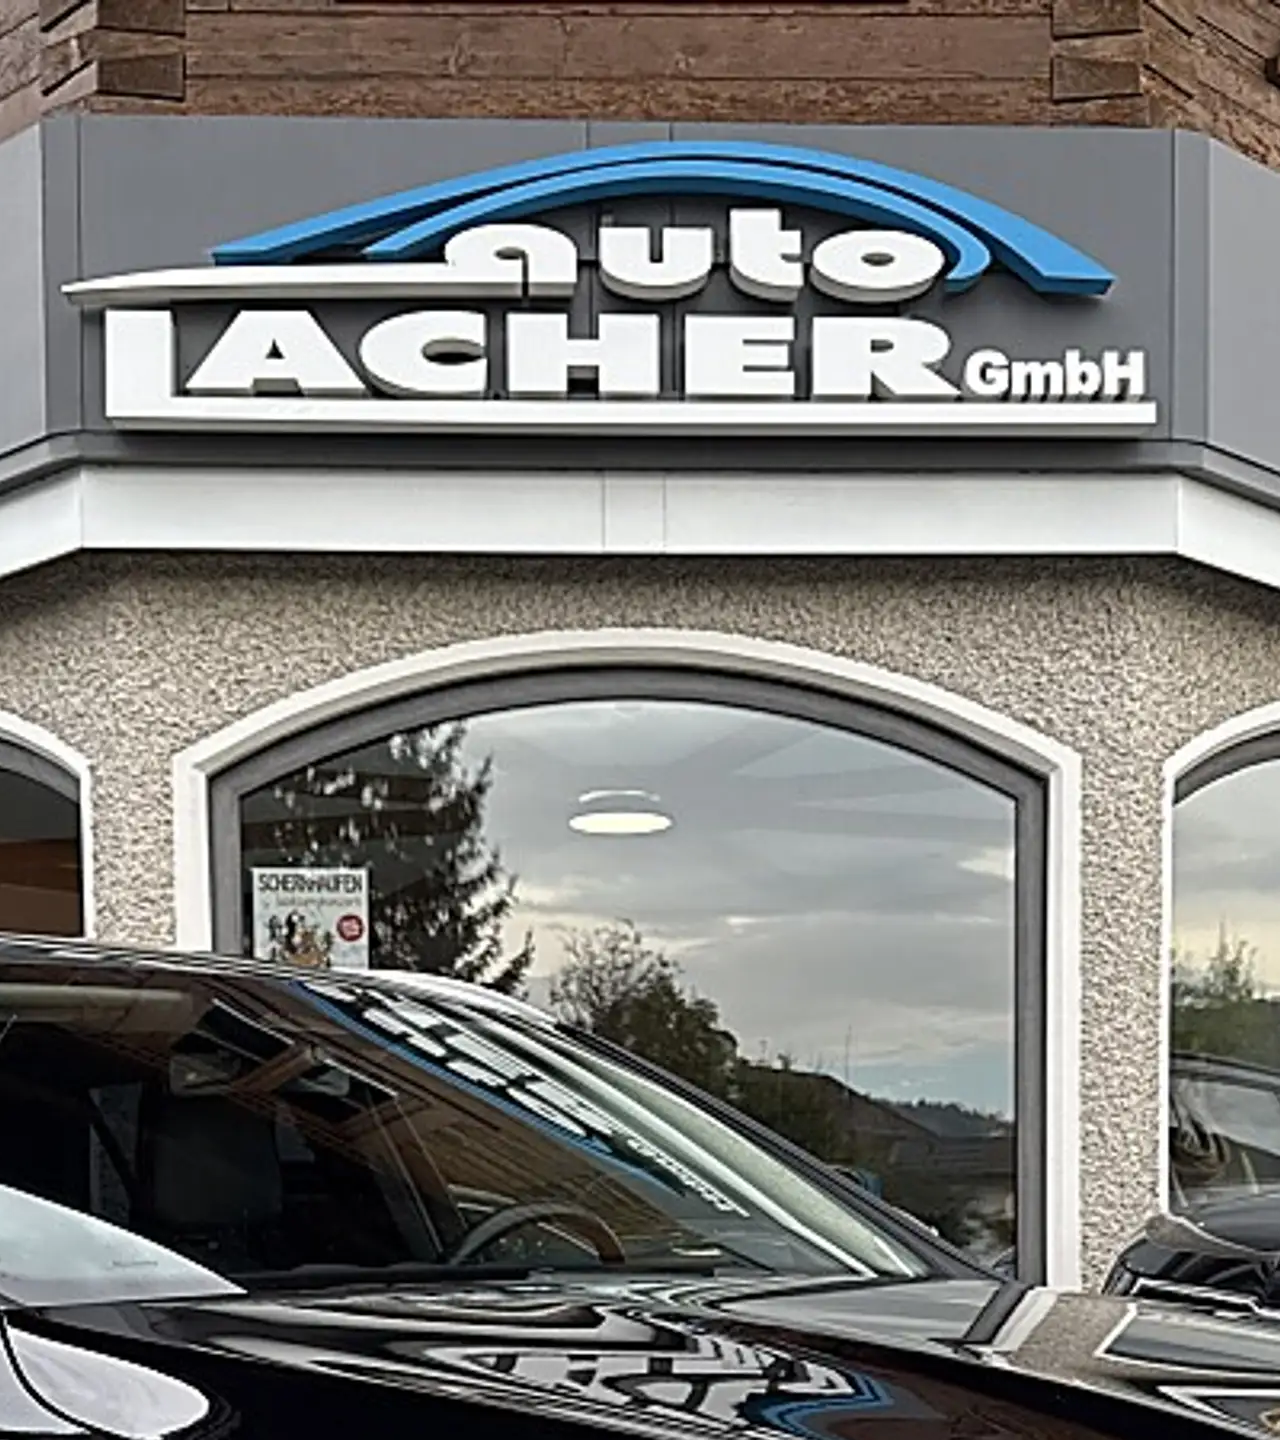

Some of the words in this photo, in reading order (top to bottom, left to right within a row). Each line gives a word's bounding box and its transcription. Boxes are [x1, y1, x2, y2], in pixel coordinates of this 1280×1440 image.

[442, 207, 948, 300] auto
[105, 306, 962, 422] LACHER
[964, 347, 1145, 397] GmbH
